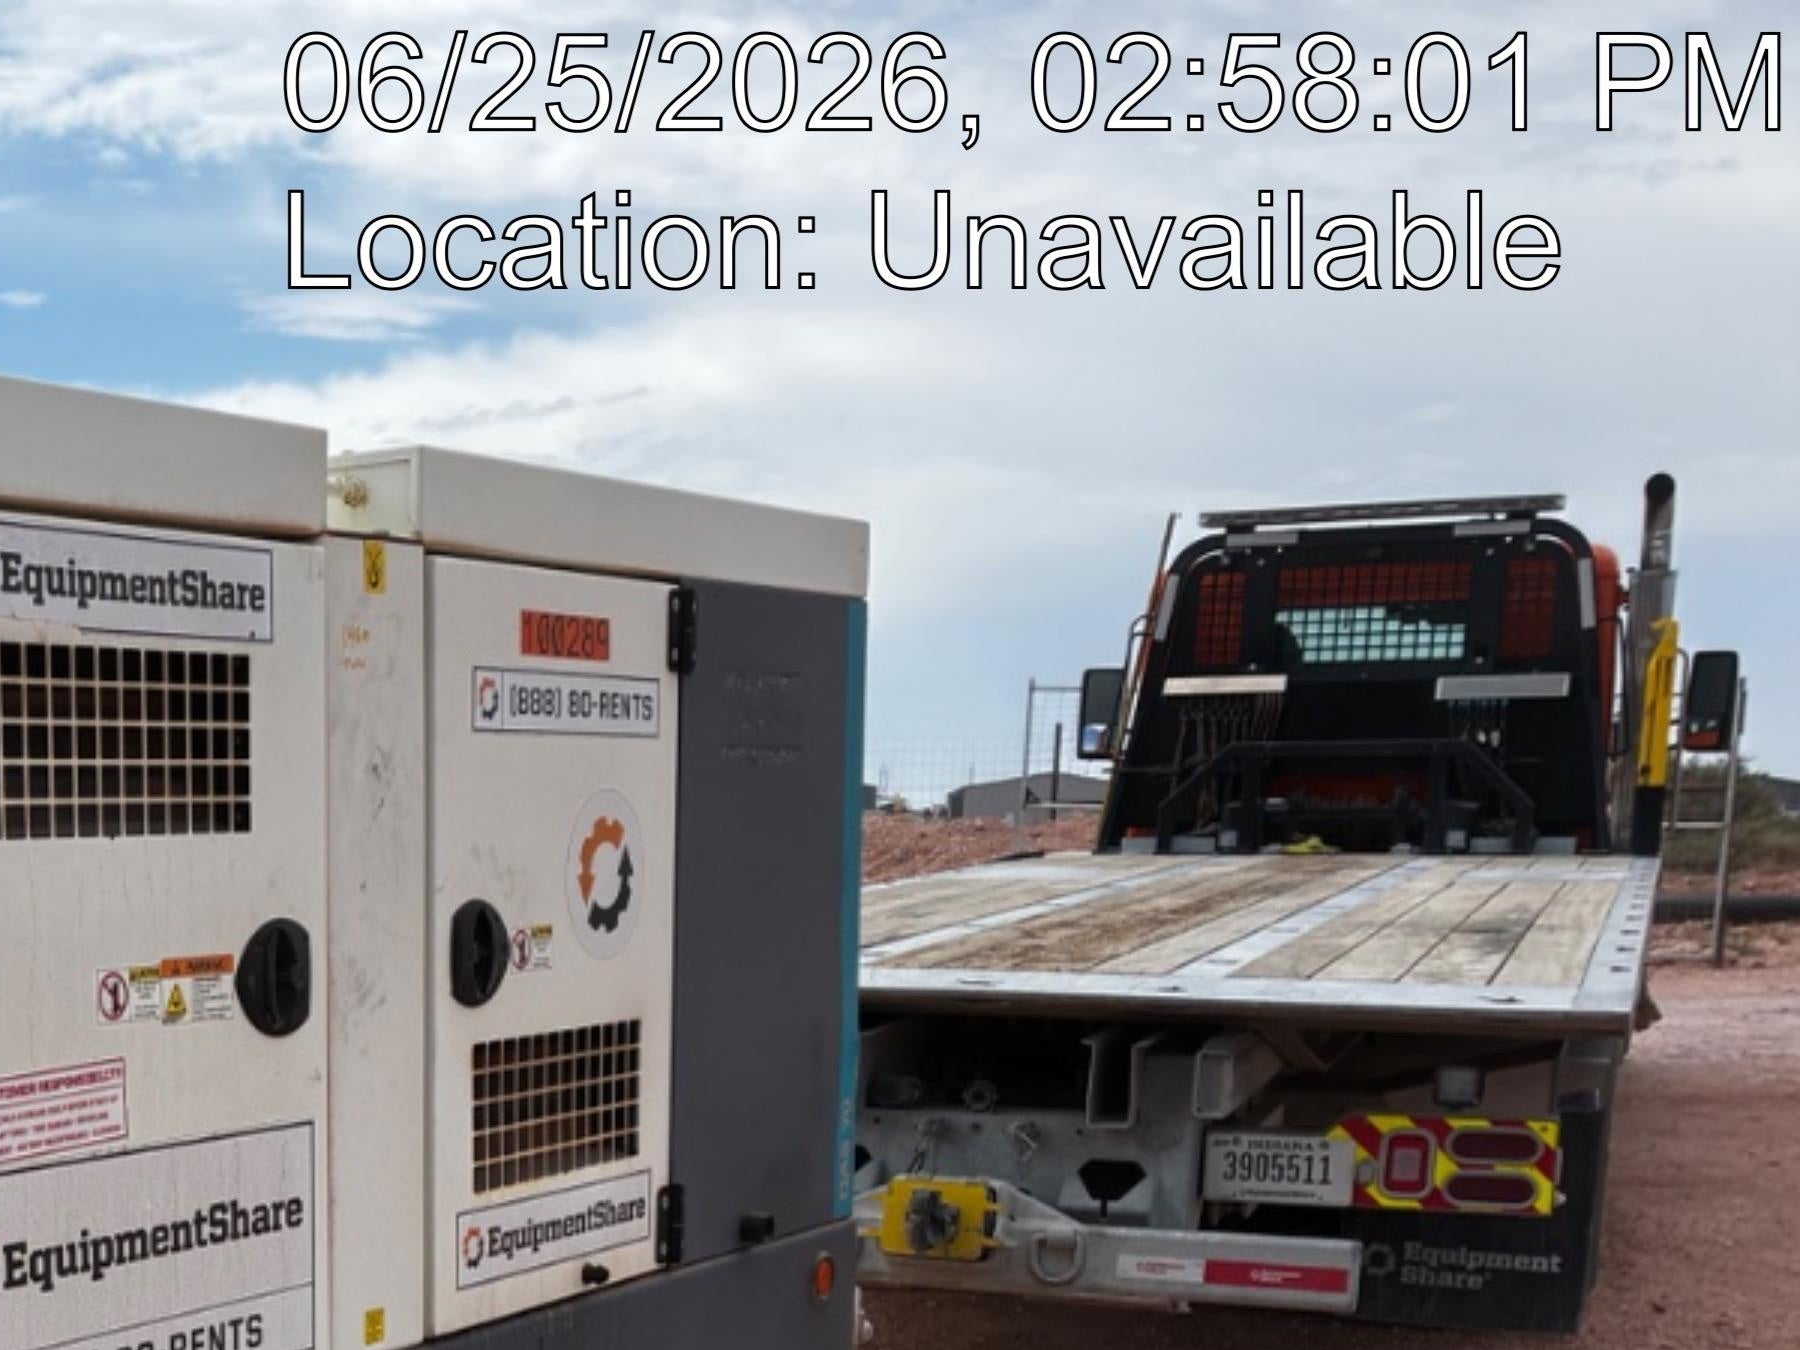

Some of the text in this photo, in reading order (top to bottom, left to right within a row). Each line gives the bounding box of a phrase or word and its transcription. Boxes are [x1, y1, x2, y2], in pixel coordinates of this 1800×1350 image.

[0, 551, 266, 613] EquipmentShare
[521, 612, 609, 660] 100289
[509, 684, 654, 722] (888) 80-RENTS
[1223, 1151, 1333, 1186] 3905511
[2, 1196, 304, 1293] EquipmentShare
[487, 1195, 646, 1261] EquipmentShare
[1402, 1240, 1564, 1273] Equipment
